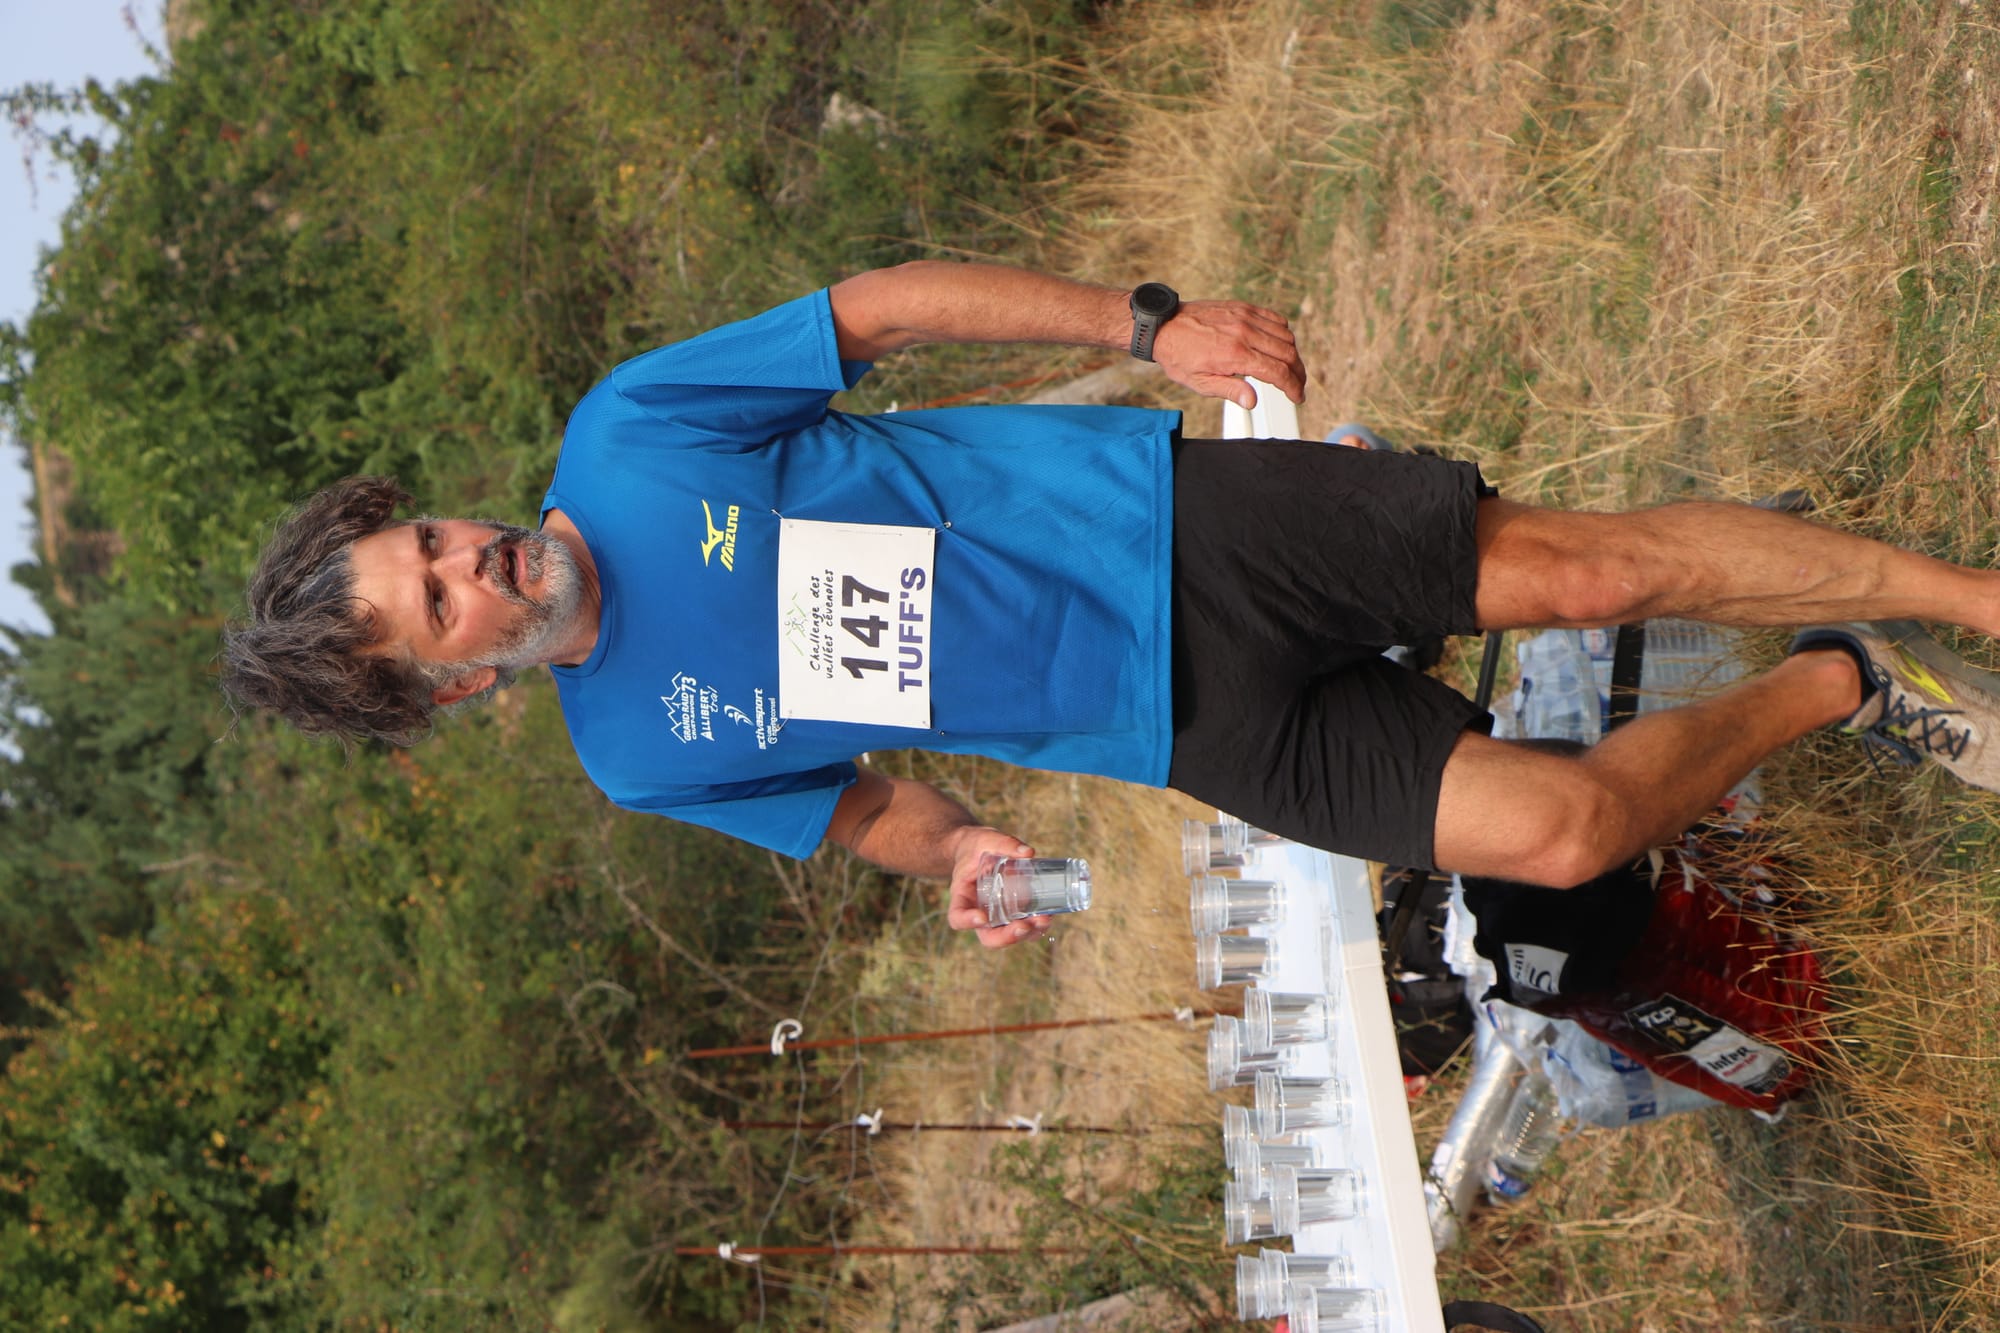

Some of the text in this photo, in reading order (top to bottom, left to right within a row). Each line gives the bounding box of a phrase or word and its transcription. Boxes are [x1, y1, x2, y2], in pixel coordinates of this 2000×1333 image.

[720, 505, 739, 572] MIZUNO
[810, 576, 825, 671] Challenge des
[821, 569, 834, 679] vallées cévenoles
[841, 575, 890, 679] 147
[899, 567, 926, 692] TUFF'S
[681, 677, 697, 741] GRAND RAID 73
[700, 689, 715, 741] ALLIBERT
[754, 688, 766, 750] activasport
